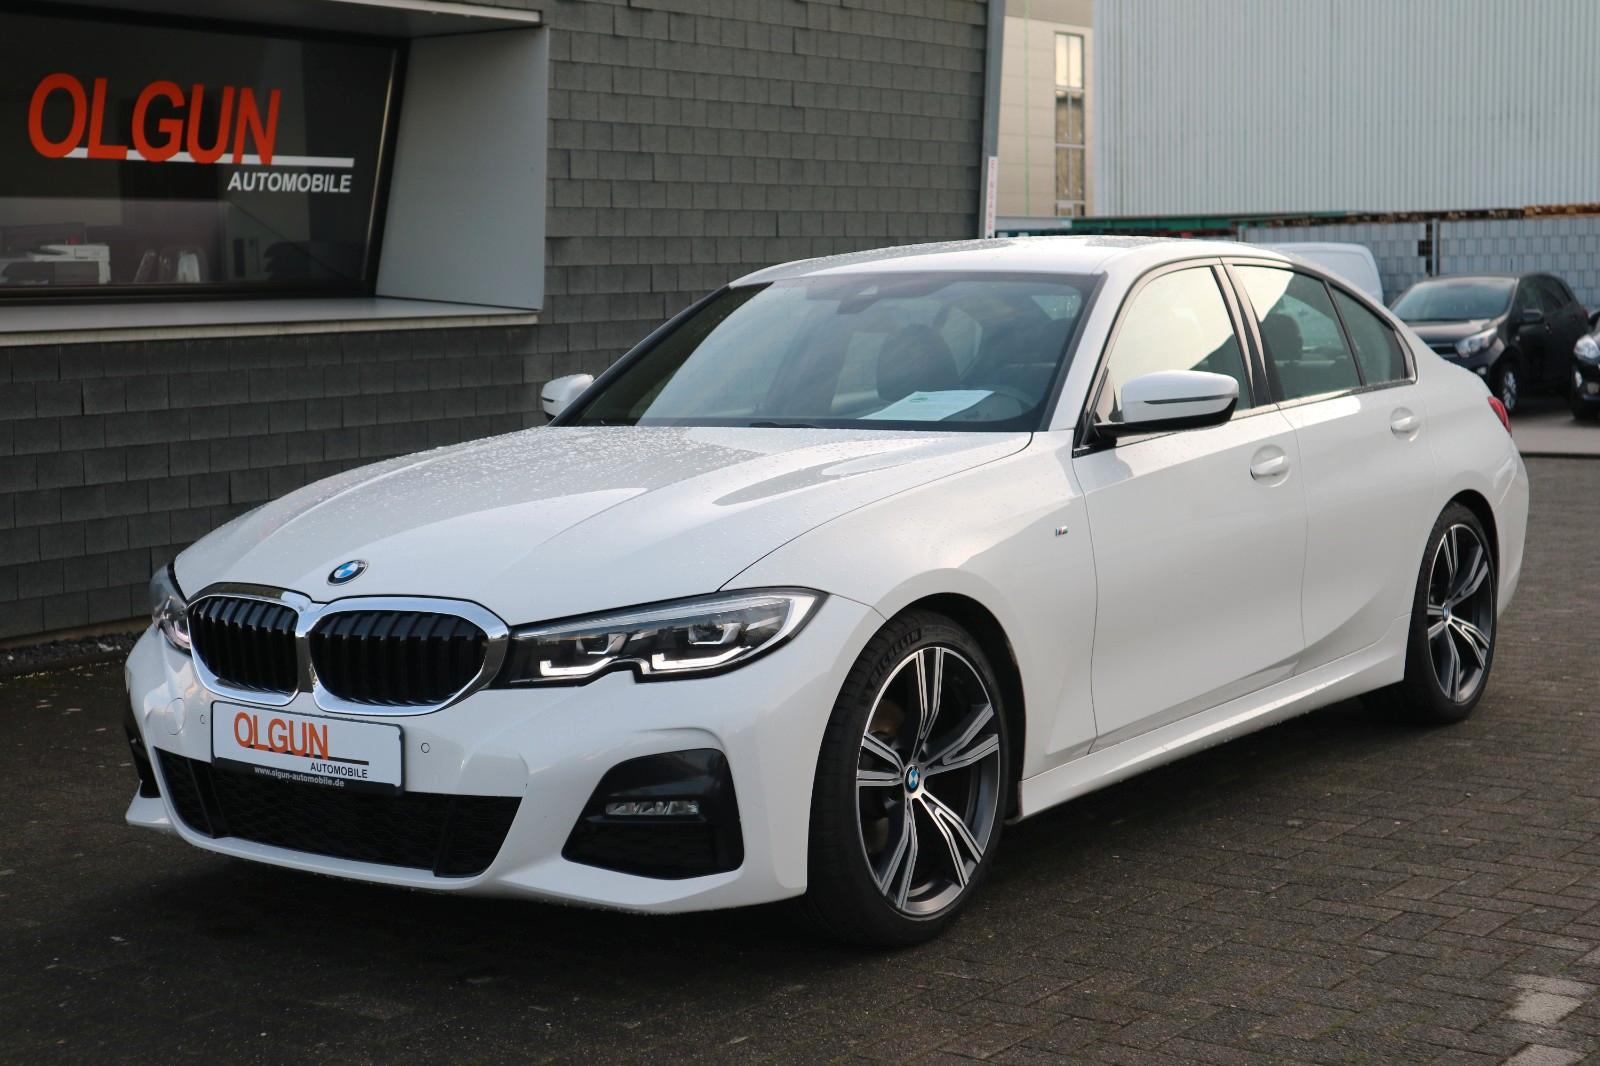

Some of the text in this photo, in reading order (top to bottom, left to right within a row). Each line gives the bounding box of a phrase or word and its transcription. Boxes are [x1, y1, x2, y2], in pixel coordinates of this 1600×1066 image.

[28, 73, 281, 165] OLGUN
[227, 172, 352, 193] AUTOMOBILE
[234, 712, 329, 760] OLGUN
[254, 767, 345, 787] www.olgun-automobile.de
[310, 762, 368, 778] AUTOMOBILE
